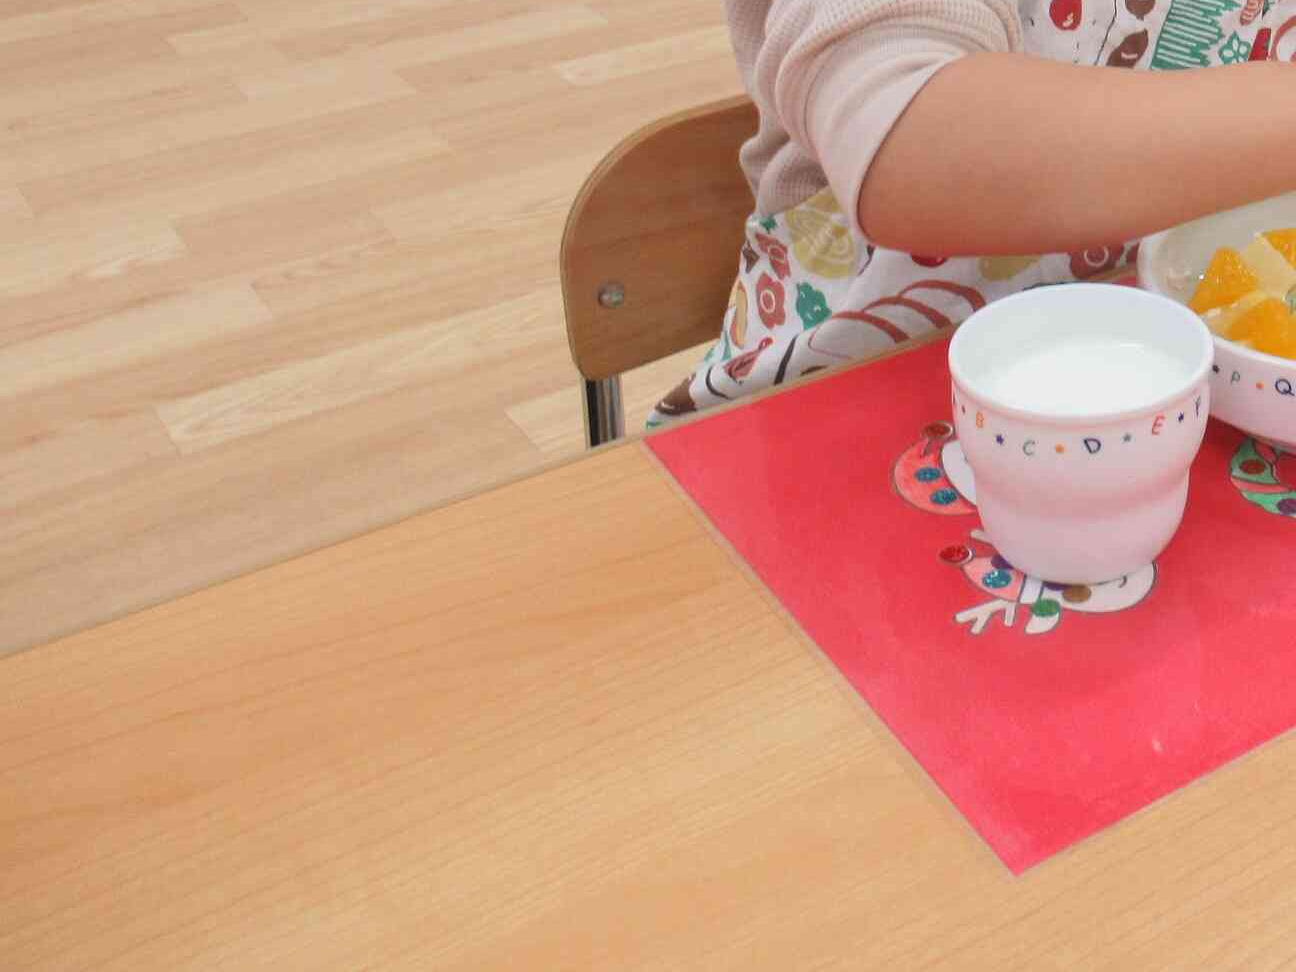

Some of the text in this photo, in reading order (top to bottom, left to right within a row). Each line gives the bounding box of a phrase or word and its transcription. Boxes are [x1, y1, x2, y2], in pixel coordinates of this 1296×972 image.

[1274, 378, 1295, 397] Q
[1022, 440, 1037, 456] C
[1084, 438, 1102, 455] D
[1151, 415, 1167, 436] E
